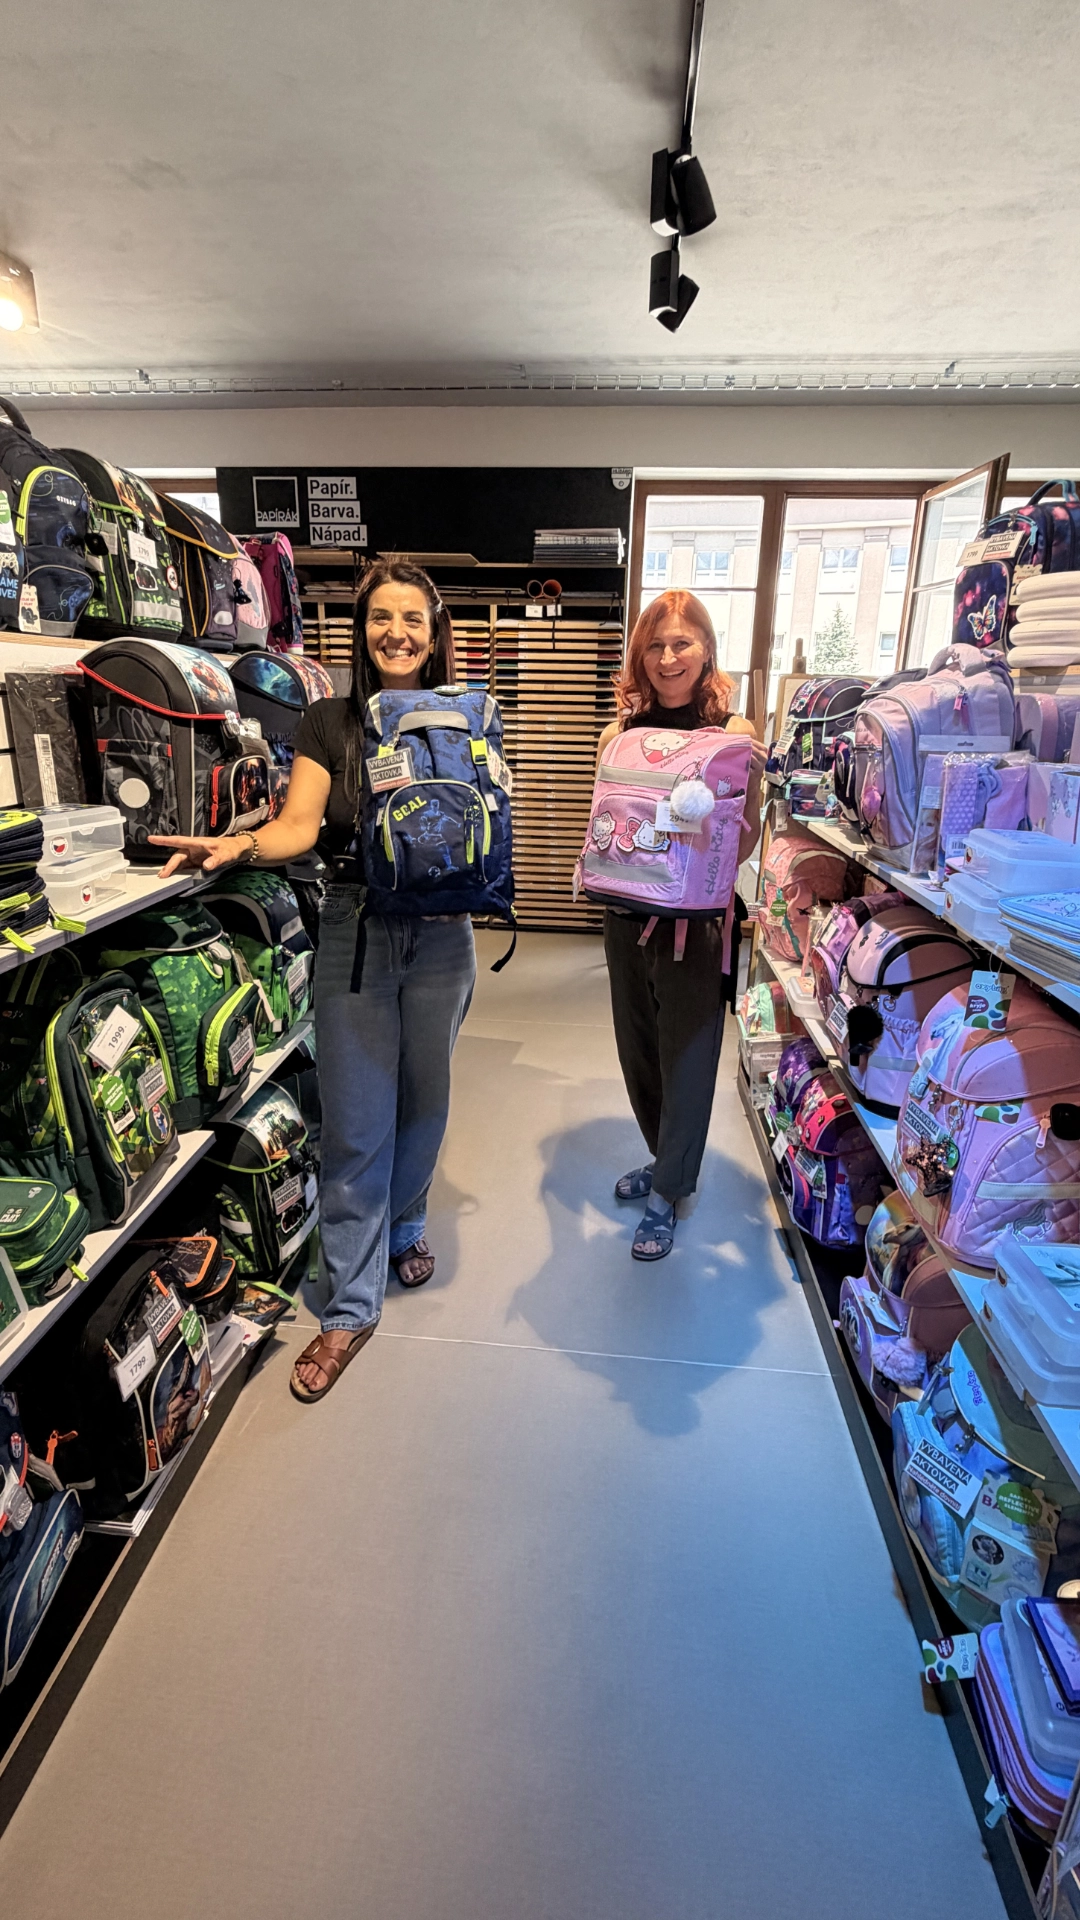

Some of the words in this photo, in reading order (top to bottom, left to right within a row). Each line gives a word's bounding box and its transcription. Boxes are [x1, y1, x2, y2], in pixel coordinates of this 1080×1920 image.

[310, 479, 353, 498] Papír.
[257, 508, 298, 522] PAPÍRÁK
[311, 503, 359, 518] Barva.
[312, 526, 366, 543] Nápad.
[0, 578, 19, 589] AME
[0, 589, 17, 599] VER
[705, 855, 721, 896] Hello
[913, 1455, 957, 1491] AKTOVKA
